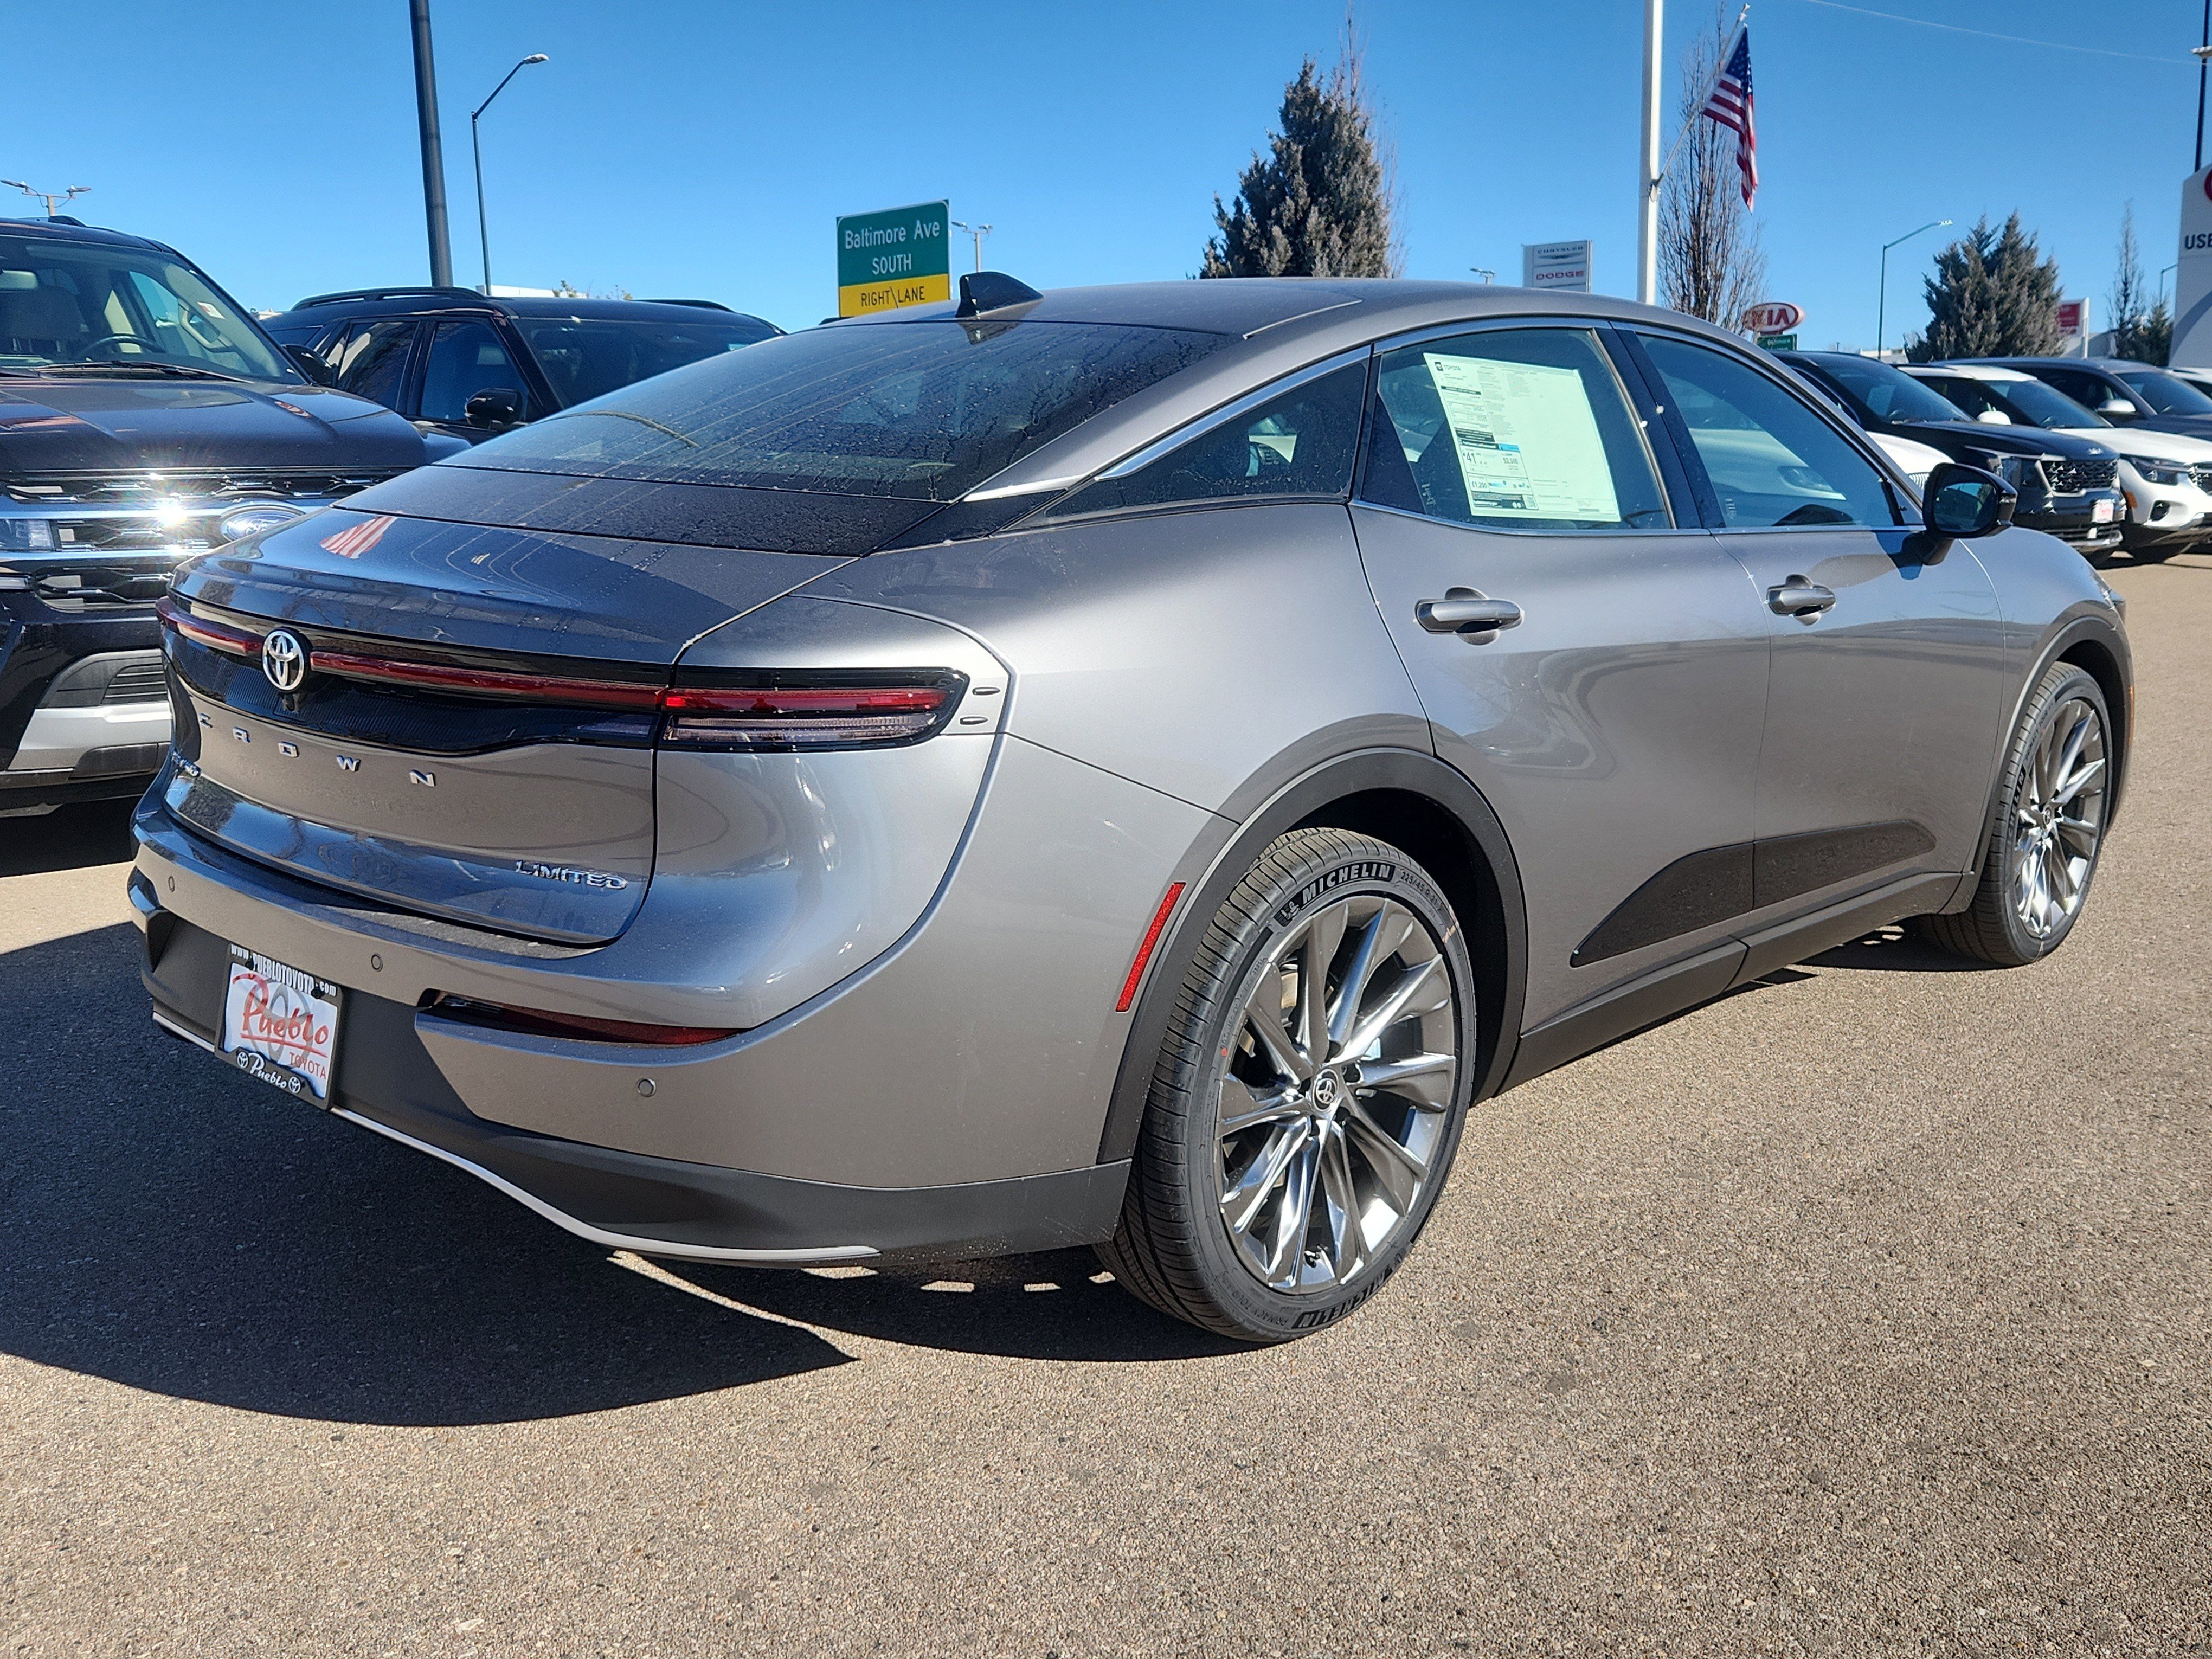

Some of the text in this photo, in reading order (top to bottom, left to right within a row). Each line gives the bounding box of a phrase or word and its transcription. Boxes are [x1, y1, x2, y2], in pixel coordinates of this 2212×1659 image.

[845, 219, 940, 249] Baltimore Ave
[872, 253, 912, 275] SOUTH
[1537, 246, 1584, 254] CHRYSLER
[1536, 271, 1584, 280] DODGE
[861, 286, 925, 307] RIGHT LANE
[1751, 308, 1790, 327] KIA
[515, 860, 627, 890] LIMITED
[1302, 864, 1391, 905] MICHELIN
[232, 973, 329, 1045] Pueblo
[248, 1052, 287, 1089] Pueblo
[289, 1051, 326, 1079] TOYOTA
